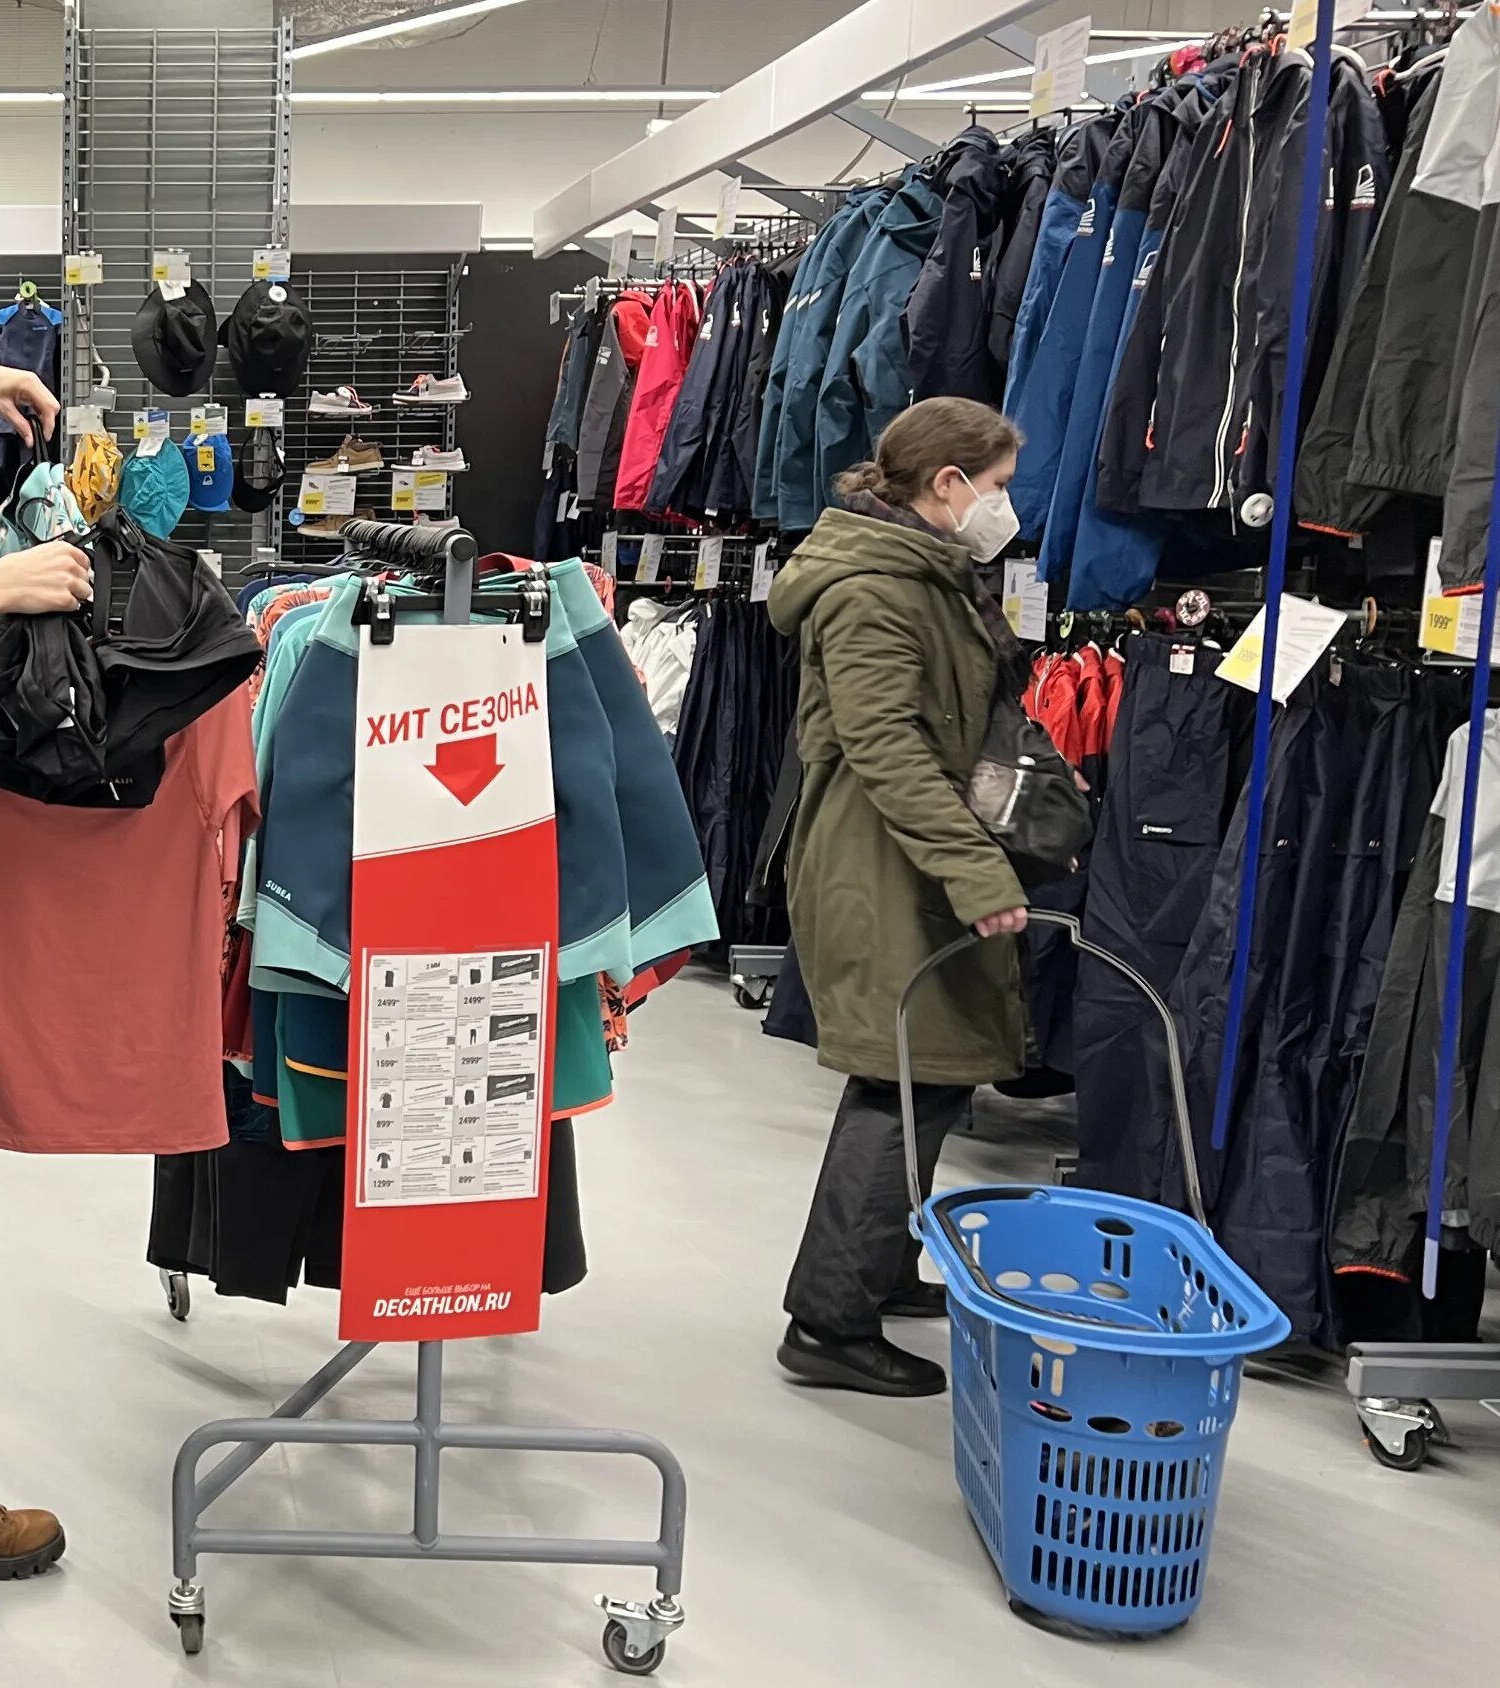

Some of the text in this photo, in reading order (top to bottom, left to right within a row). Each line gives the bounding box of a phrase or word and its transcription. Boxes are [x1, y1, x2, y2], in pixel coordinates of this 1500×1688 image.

[366, 682, 539, 747] ХИТ СЕЗОНА
[265, 879, 293, 902] SUBEA
[377, 999, 396, 1007] 2499
[463, 996, 481, 1005] 2499
[376, 1120, 390, 1128] 899
[372, 1291, 512, 1318] DECATHLON.RU
